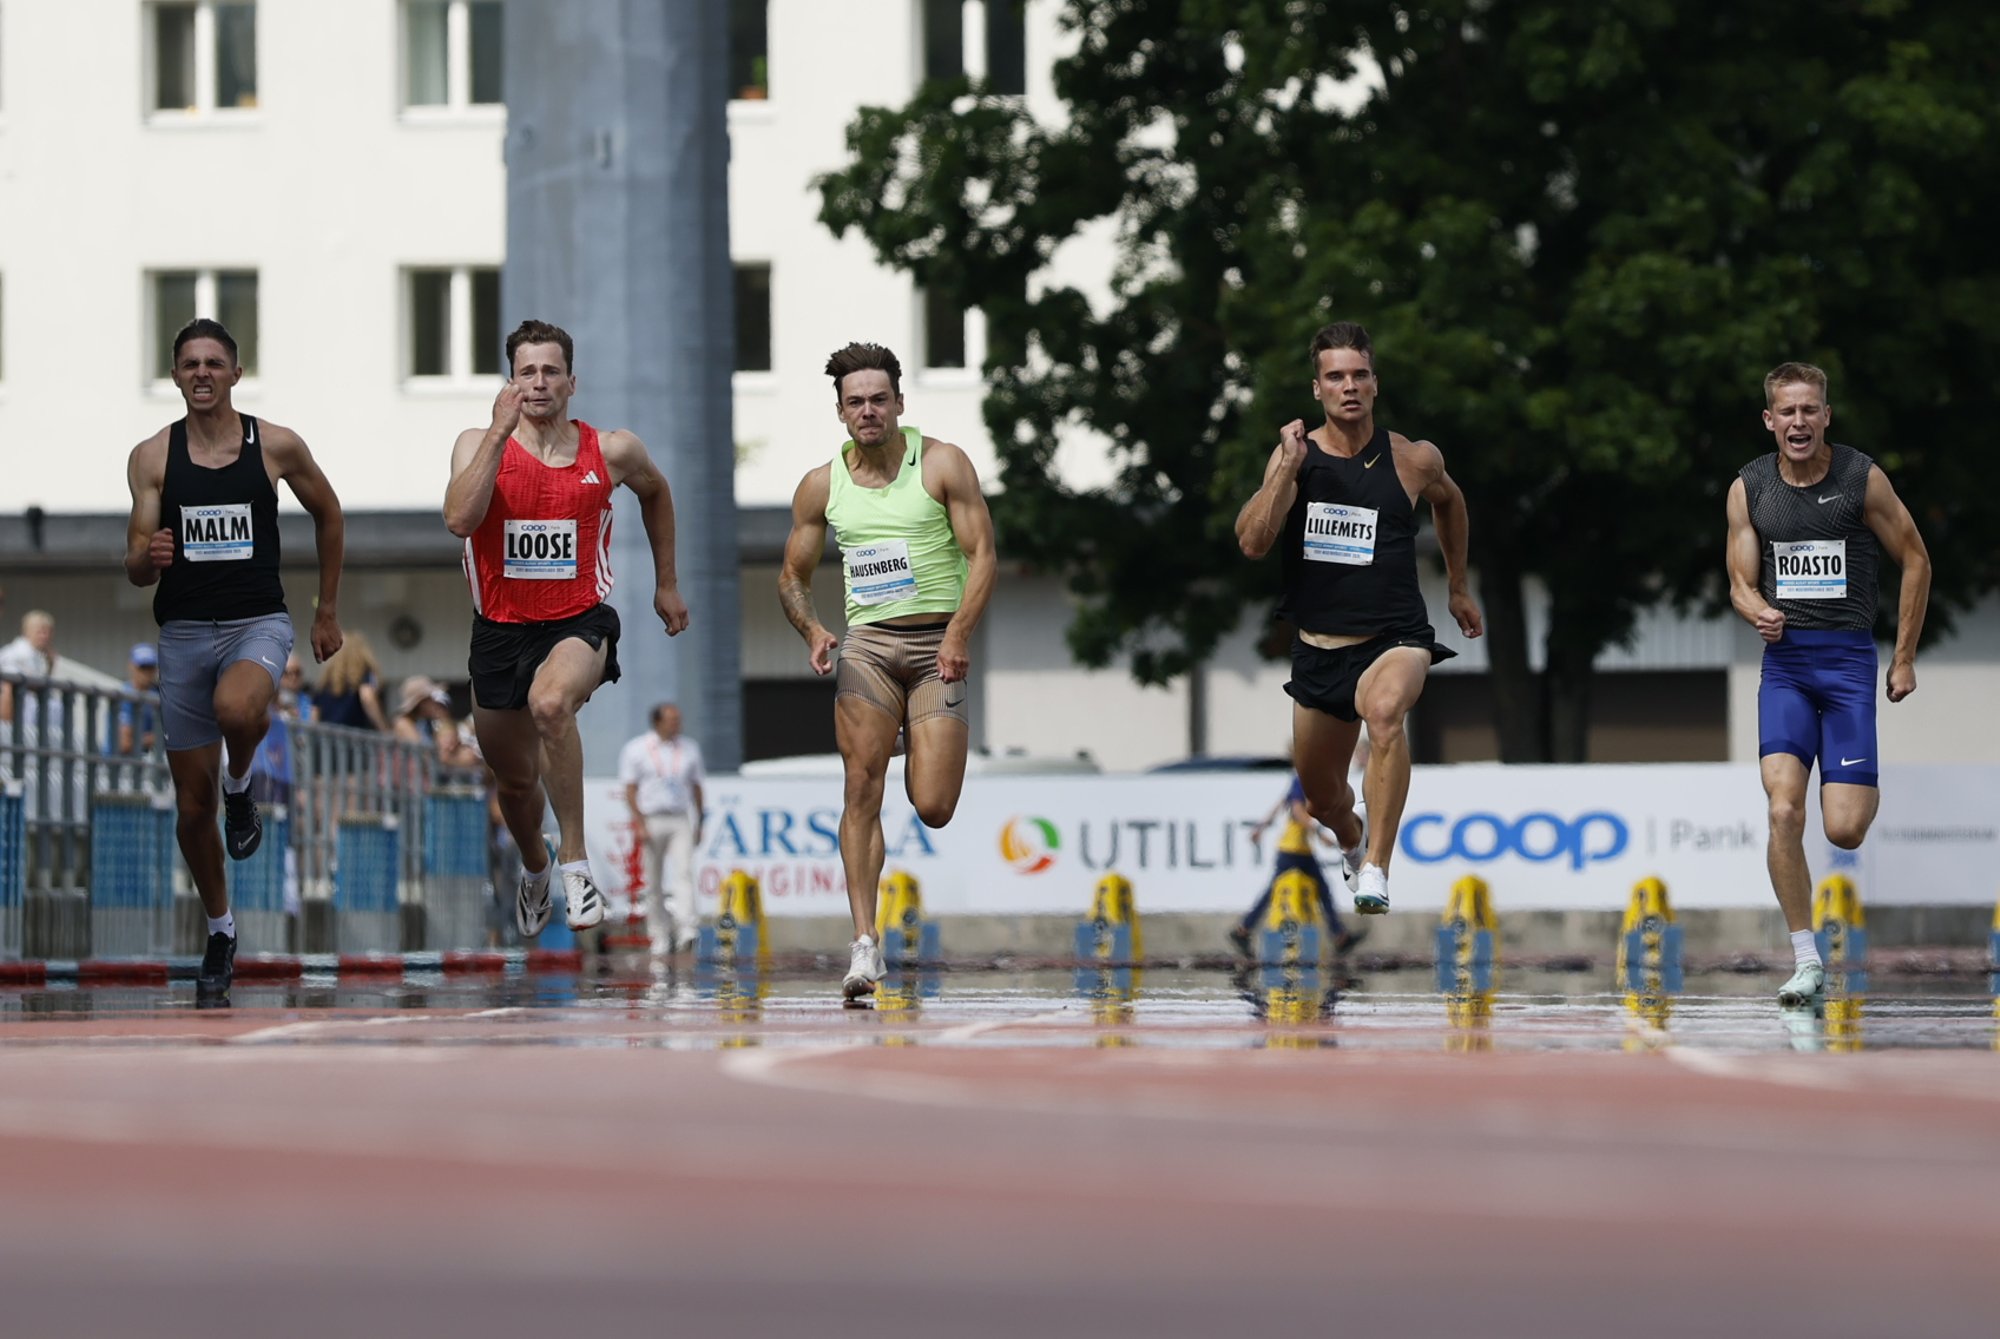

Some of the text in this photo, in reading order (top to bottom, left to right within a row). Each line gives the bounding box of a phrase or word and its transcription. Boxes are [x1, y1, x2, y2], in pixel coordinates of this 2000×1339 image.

[1323, 507, 1348, 517] coop
[185, 516, 250, 542] MALM
[521, 524, 547, 532] coop
[1307, 518, 1373, 540] LILLEMETS
[508, 533, 572, 559] LOOSE
[856, 548, 876, 557] coop
[1790, 544, 1815, 552] coop
[849, 557, 908, 578] HAUSENBERG
[1778, 555, 1842, 576] ROASTO
[699, 794, 936, 858] ÄRSA
[1399, 811, 1759, 872] coop Pank
